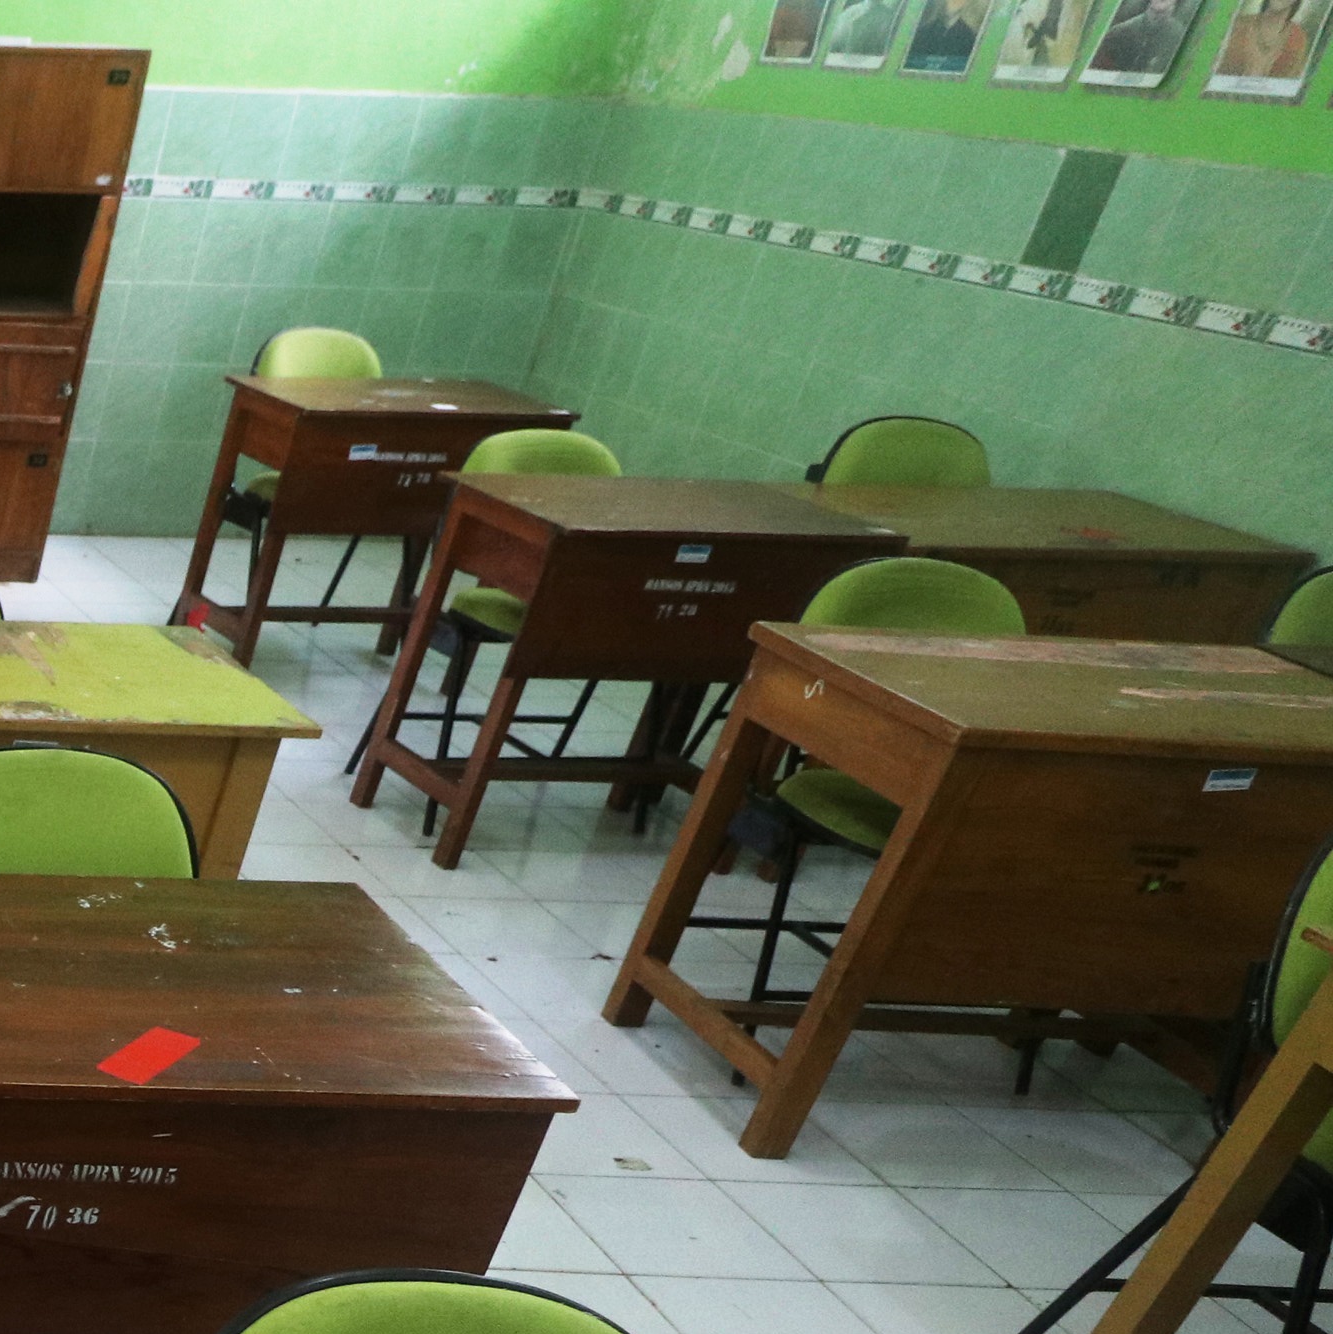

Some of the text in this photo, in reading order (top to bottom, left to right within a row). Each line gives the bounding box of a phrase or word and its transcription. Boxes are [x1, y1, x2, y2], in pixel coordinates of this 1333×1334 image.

[68, 1163, 125, 1183] APBN
[126, 1167, 178, 1185] 2015
[65, 1206, 100, 1226] 36
